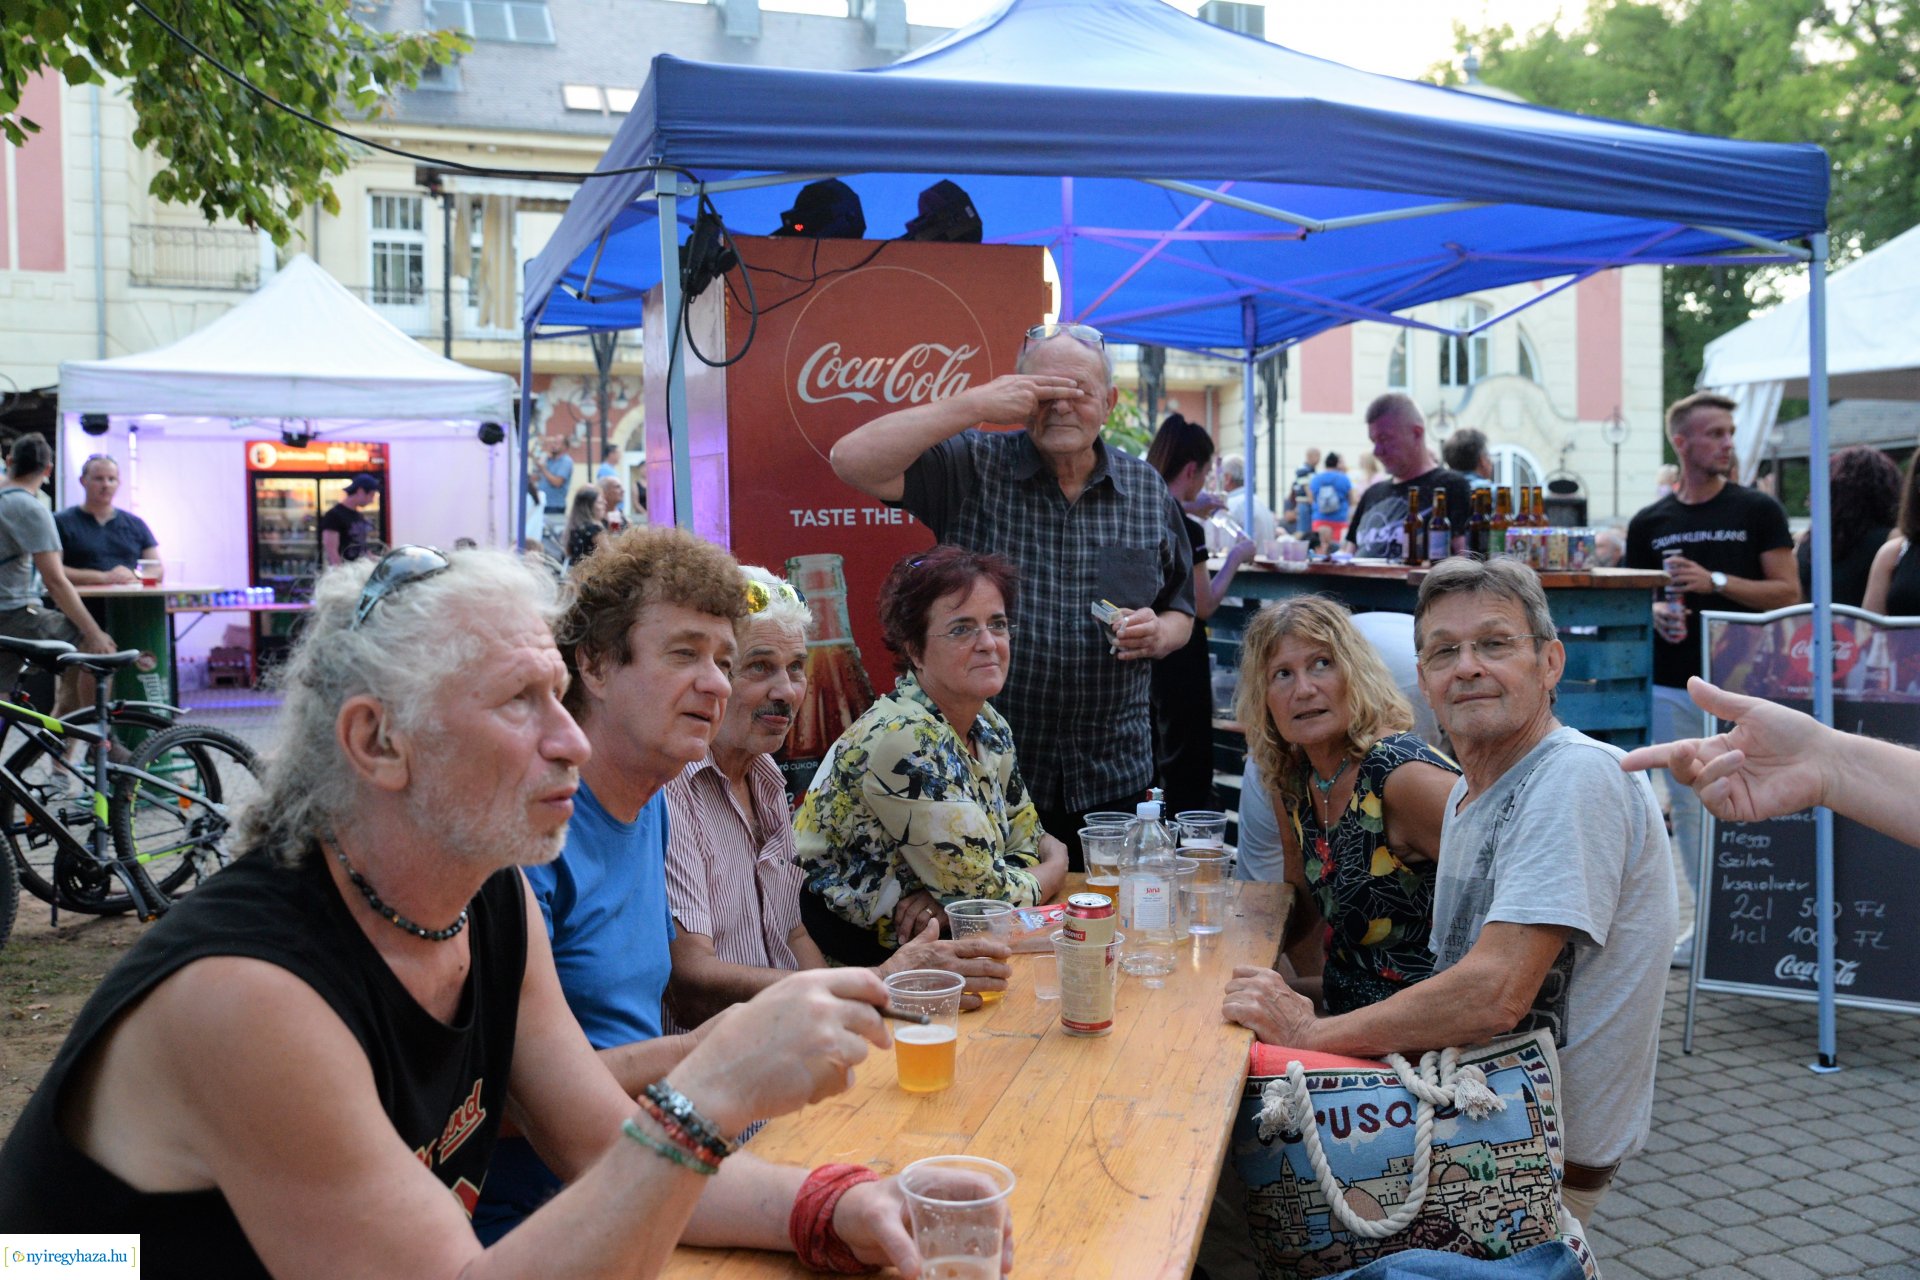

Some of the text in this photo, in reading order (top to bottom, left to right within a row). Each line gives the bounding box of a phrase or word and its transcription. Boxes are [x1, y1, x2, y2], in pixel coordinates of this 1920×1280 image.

[797, 341, 981, 404] Coca-Cola
[789, 508, 857, 527] TASTE
[861, 507, 902, 525] THE
[1651, 530, 1748, 550] CALVIN KLEIN JEANS
